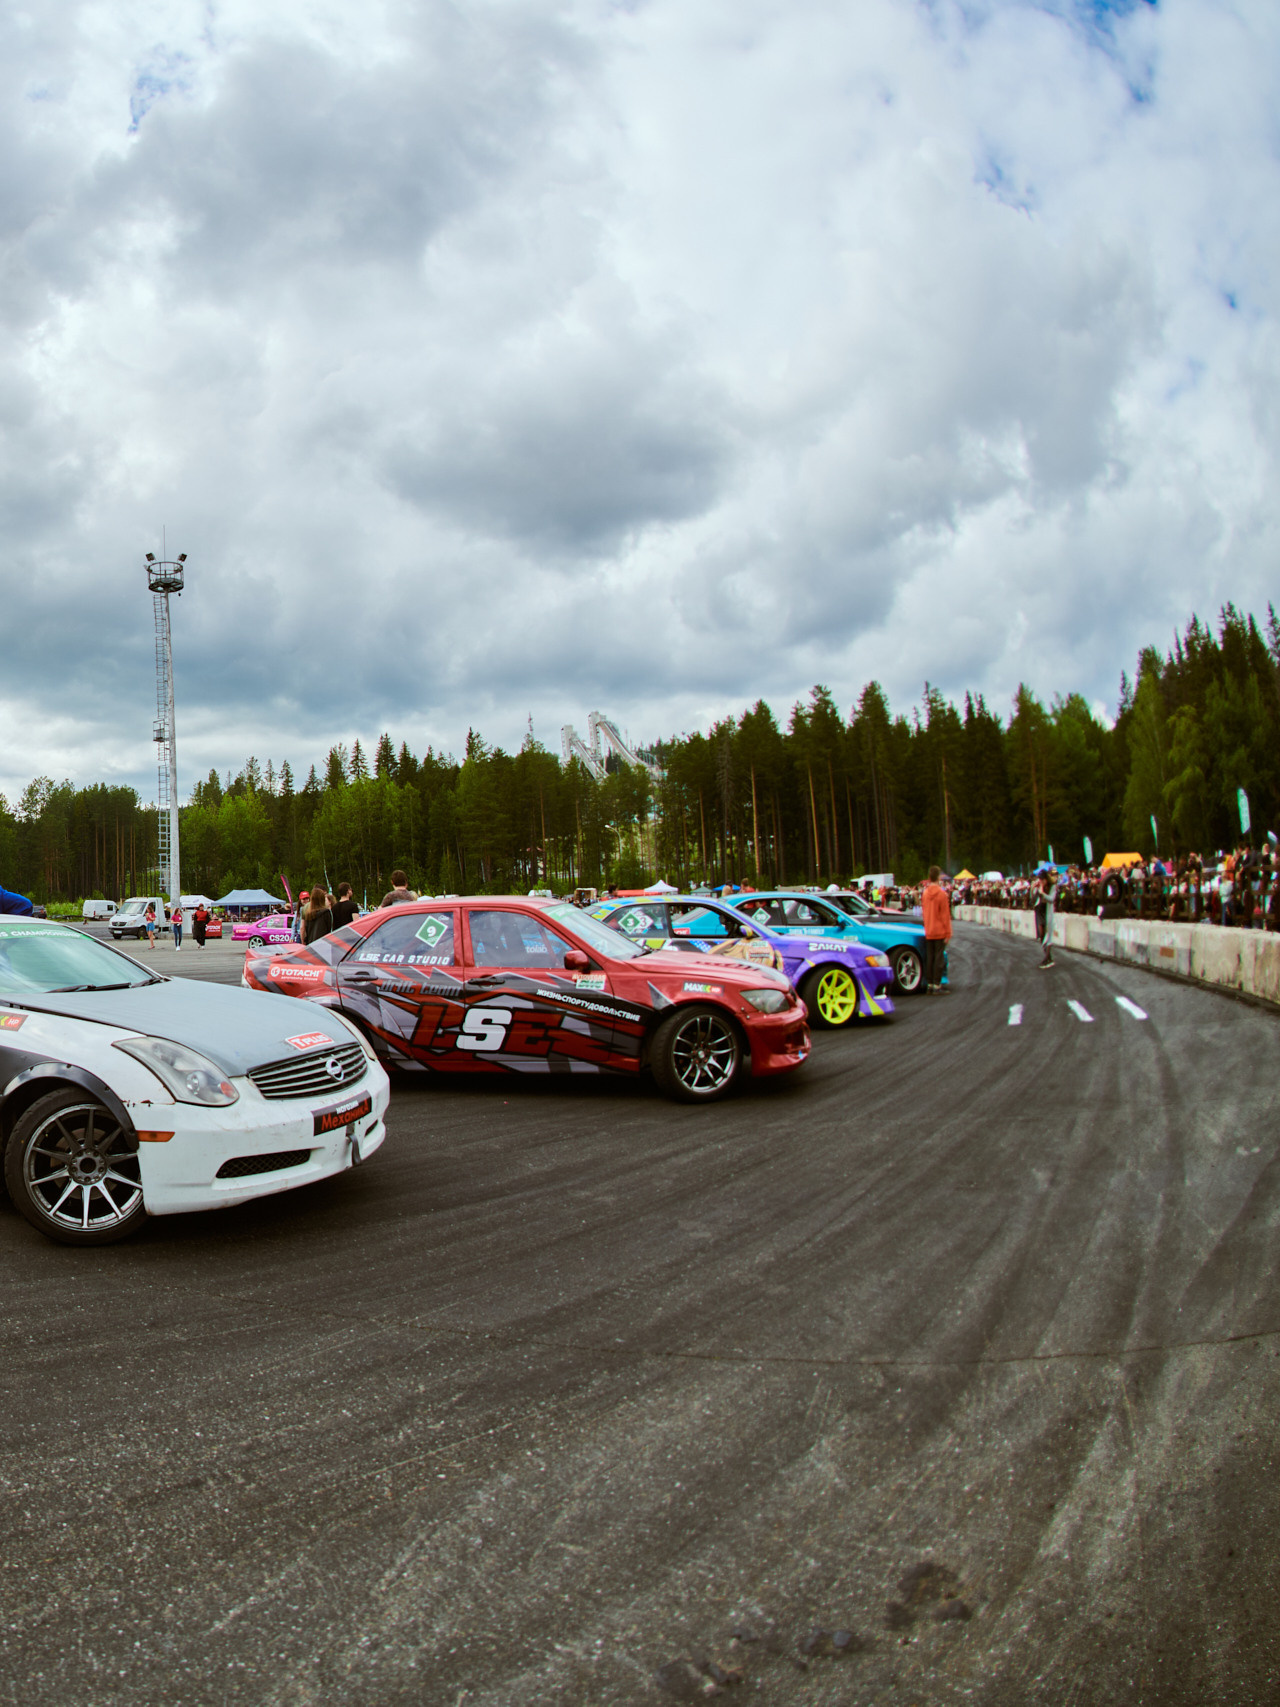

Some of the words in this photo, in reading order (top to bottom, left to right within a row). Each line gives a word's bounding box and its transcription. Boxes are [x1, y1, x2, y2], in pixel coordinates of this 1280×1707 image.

[626, 918, 635, 927] 3
[11, 930, 81, 939] CHAMPIONSHIP
[426, 926, 437, 937] 9
[382, 954, 405, 963] CAR
[408, 955, 450, 965] STUDIO
[281, 968, 320, 977] TOTACHI
[381, 980, 417, 994] drift
[420, 982, 461, 996] team
[684, 983, 704, 992] MAX
[321, 1099, 370, 1130] МеханикА
